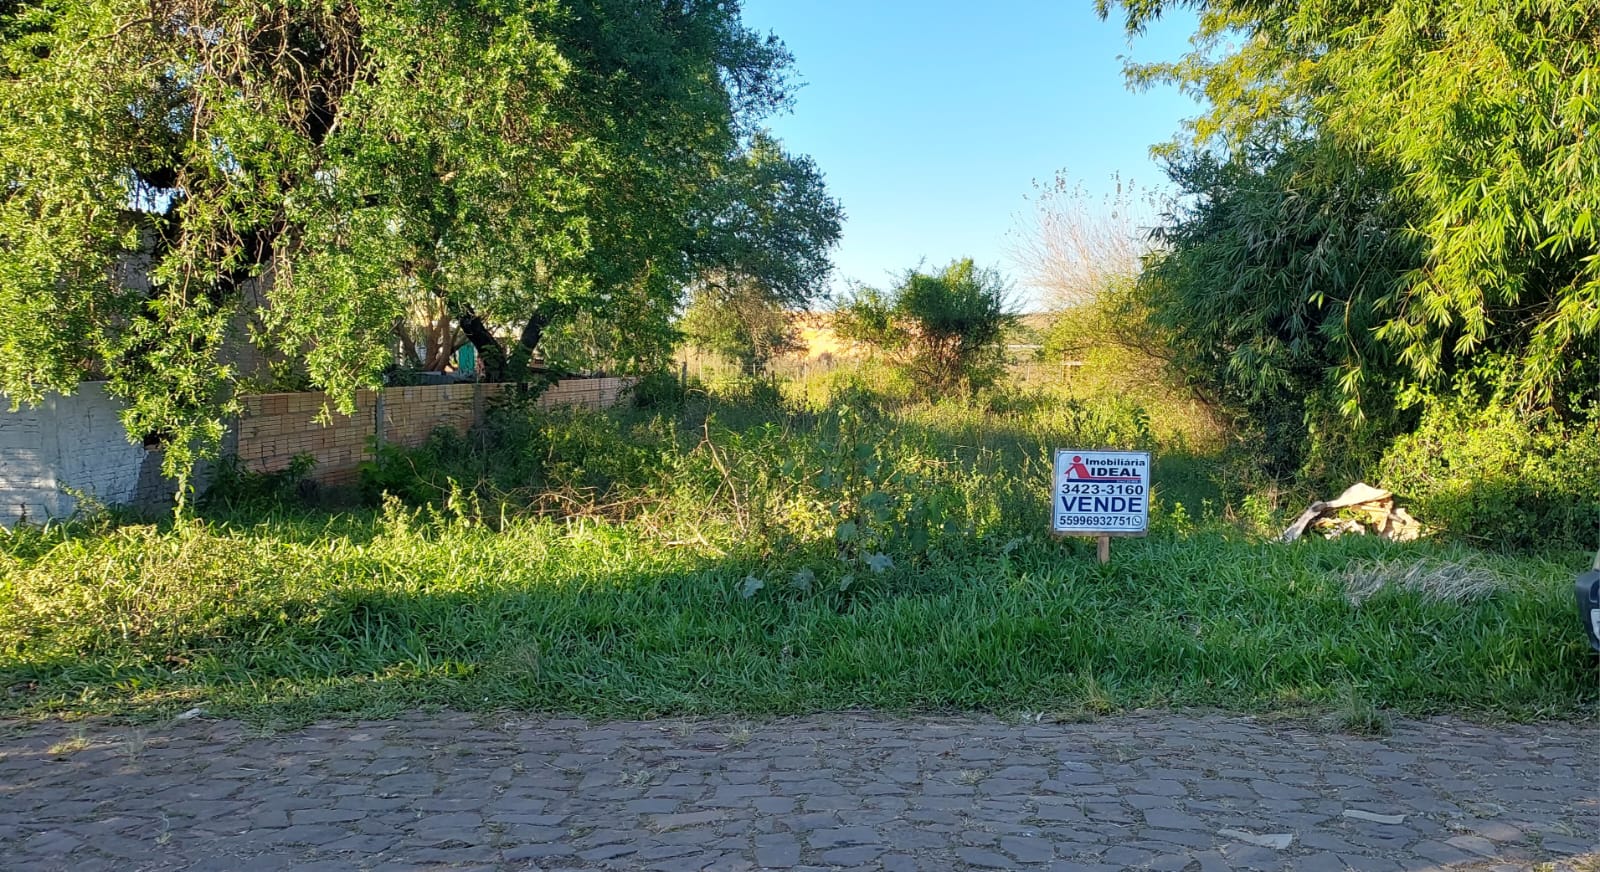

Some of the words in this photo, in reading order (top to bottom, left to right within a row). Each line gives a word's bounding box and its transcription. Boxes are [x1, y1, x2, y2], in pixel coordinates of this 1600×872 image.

[1086, 458, 1145, 466] Imobiliária
[1091, 467, 1141, 477] IDEAL
[1061, 484, 1143, 495] 3423-3160
[1061, 496, 1142, 512] VENDE
[1060, 515, 1131, 526] 55996932751
